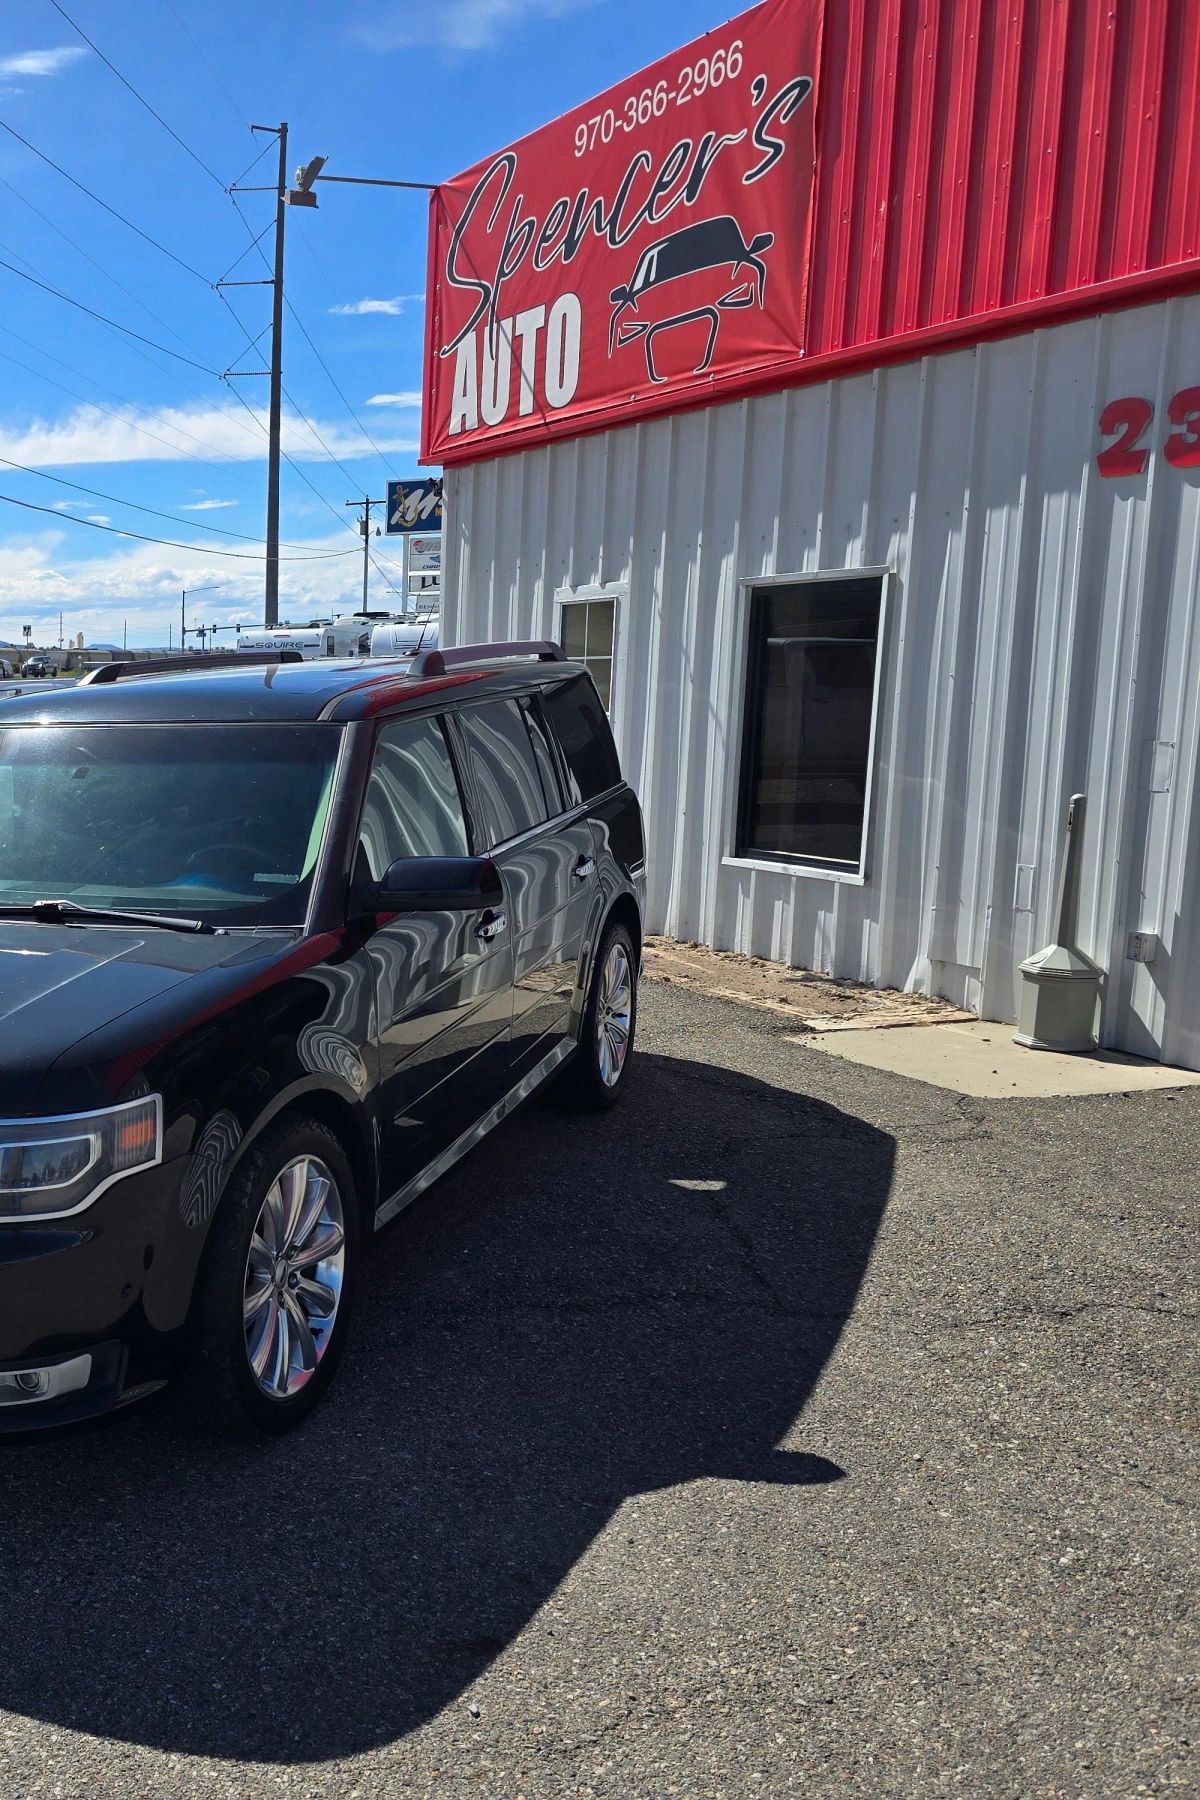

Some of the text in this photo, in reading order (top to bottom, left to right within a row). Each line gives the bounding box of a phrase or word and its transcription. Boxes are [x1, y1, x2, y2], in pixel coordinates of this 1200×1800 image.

[574, 39, 743, 158] 970-366-2966
[440, 74, 814, 360] Spencer's
[448, 292, 583, 436] AUTO
[254, 641, 304, 649] SQUIRE
